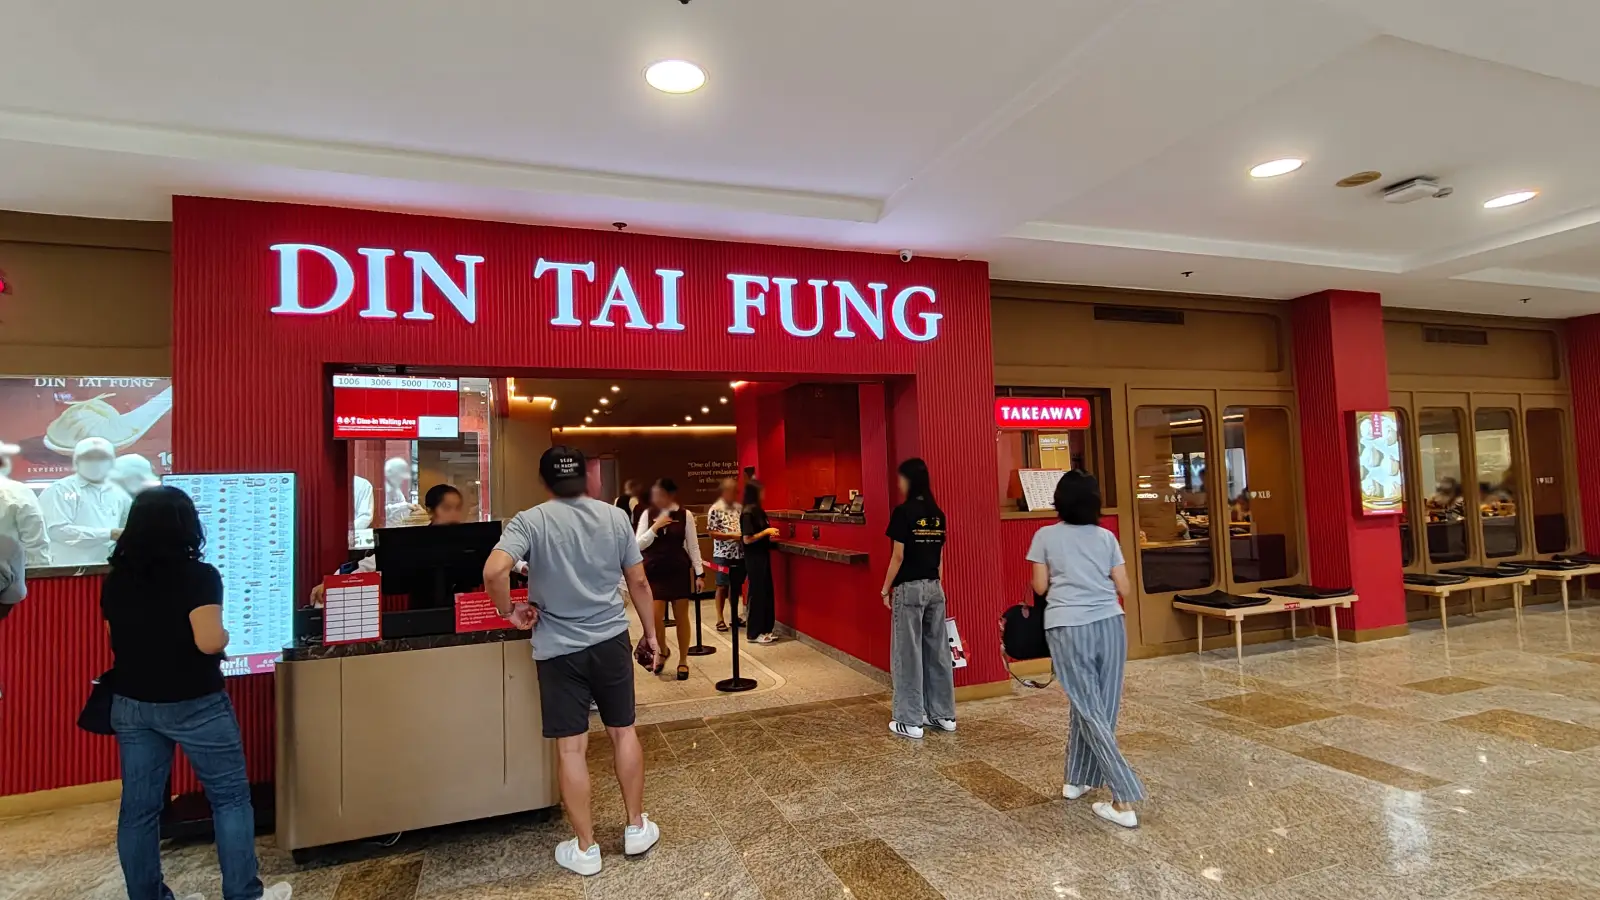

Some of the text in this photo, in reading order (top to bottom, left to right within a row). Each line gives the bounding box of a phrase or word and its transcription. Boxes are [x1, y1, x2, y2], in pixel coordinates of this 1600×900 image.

[269, 243, 944, 342] DIN TAI FUNG
[34, 378, 155, 388] DIN TAI FUNG
[339, 377, 452, 389] 1006 3006 5000 7003
[1001, 406, 1083, 420] TAKEAWAY
[220, 657, 248, 669] orld
